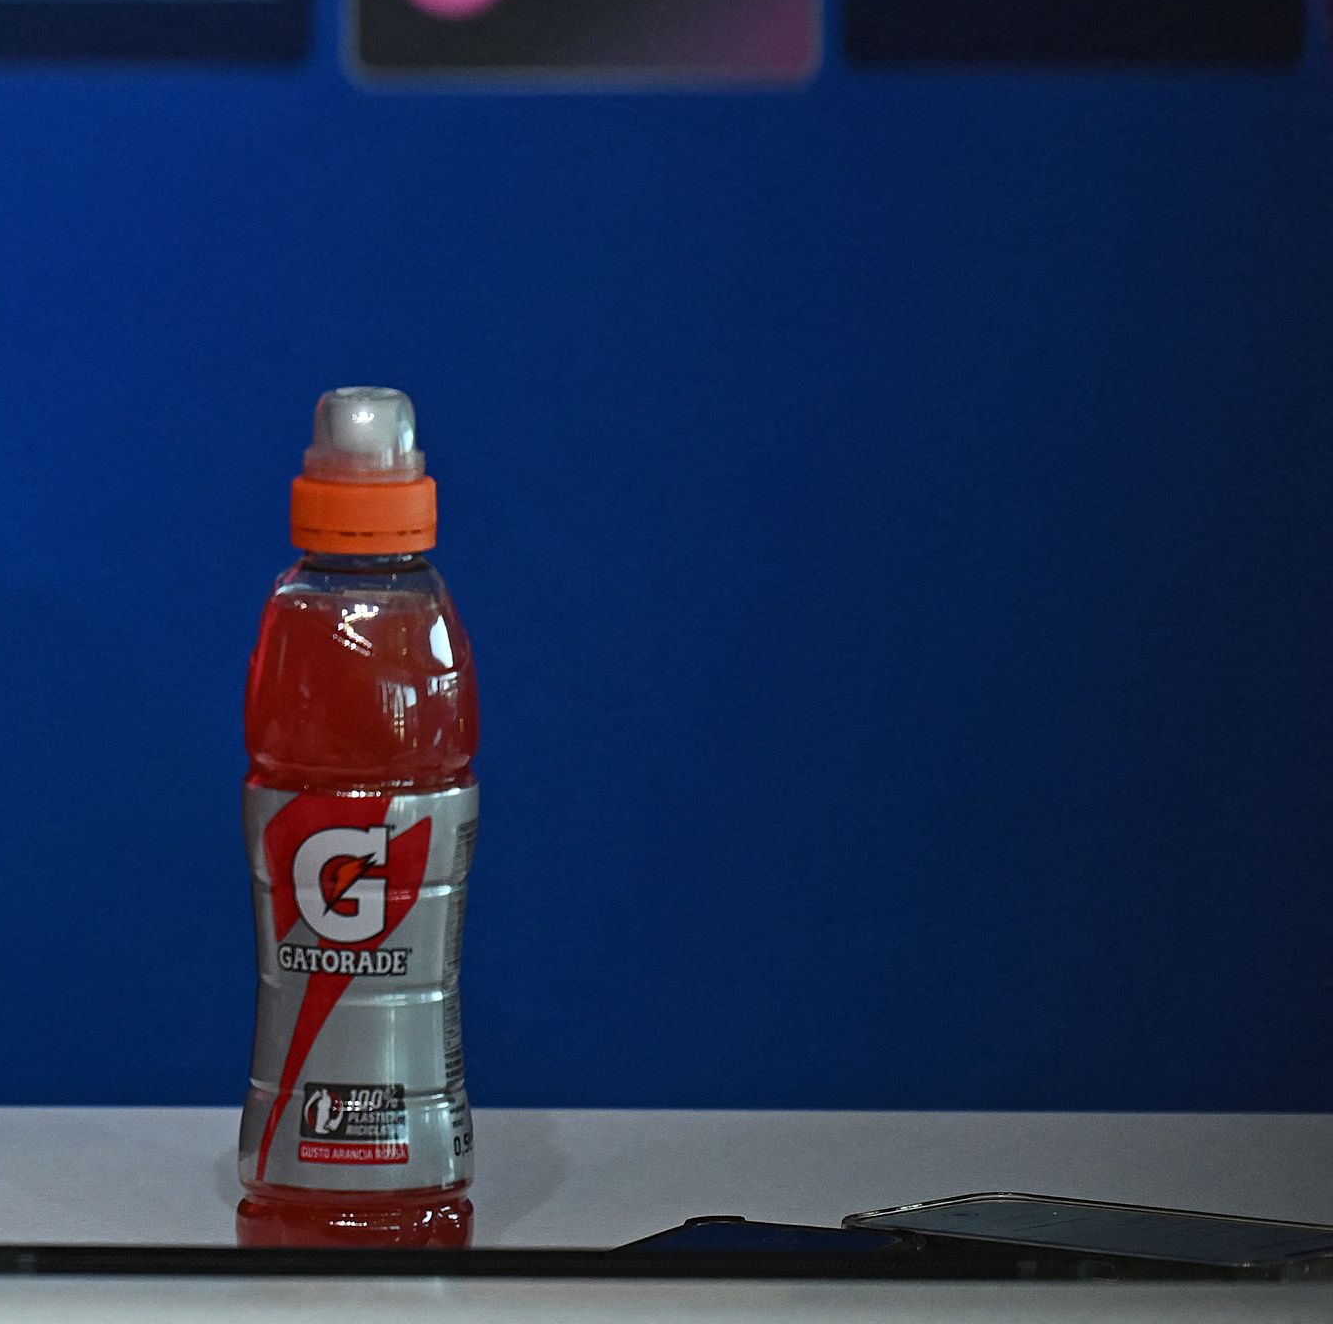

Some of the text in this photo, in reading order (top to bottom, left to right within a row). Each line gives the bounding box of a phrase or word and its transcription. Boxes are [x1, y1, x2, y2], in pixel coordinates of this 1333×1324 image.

[293, 826, 387, 944] G
[279, 945, 407, 975] GATORADE
[347, 1085, 399, 1111] 100%
